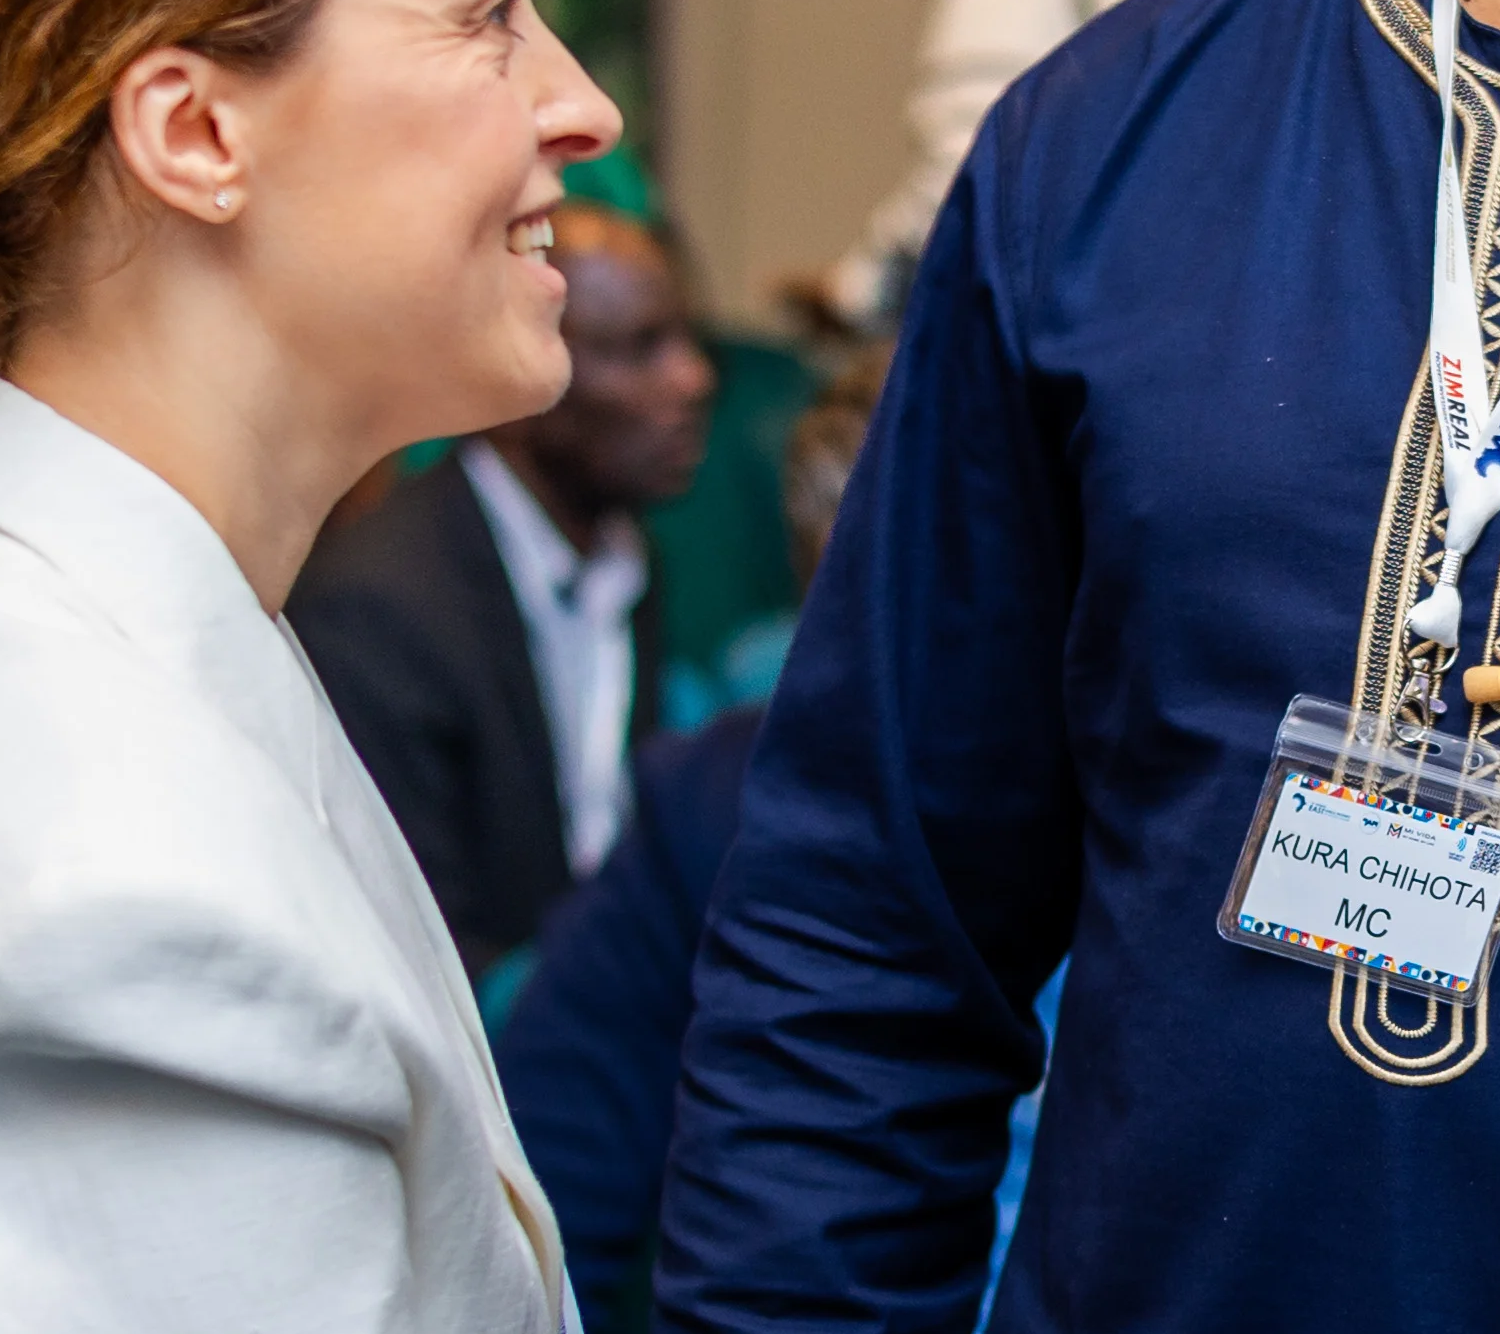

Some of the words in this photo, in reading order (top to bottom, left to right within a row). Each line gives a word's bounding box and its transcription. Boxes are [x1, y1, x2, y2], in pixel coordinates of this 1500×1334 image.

[1442, 355, 1471, 451] ZIMREAL
[1272, 830, 1349, 874] KURA
[1359, 856, 1485, 912] CHIHOTA
[1335, 898, 1391, 937] MC
